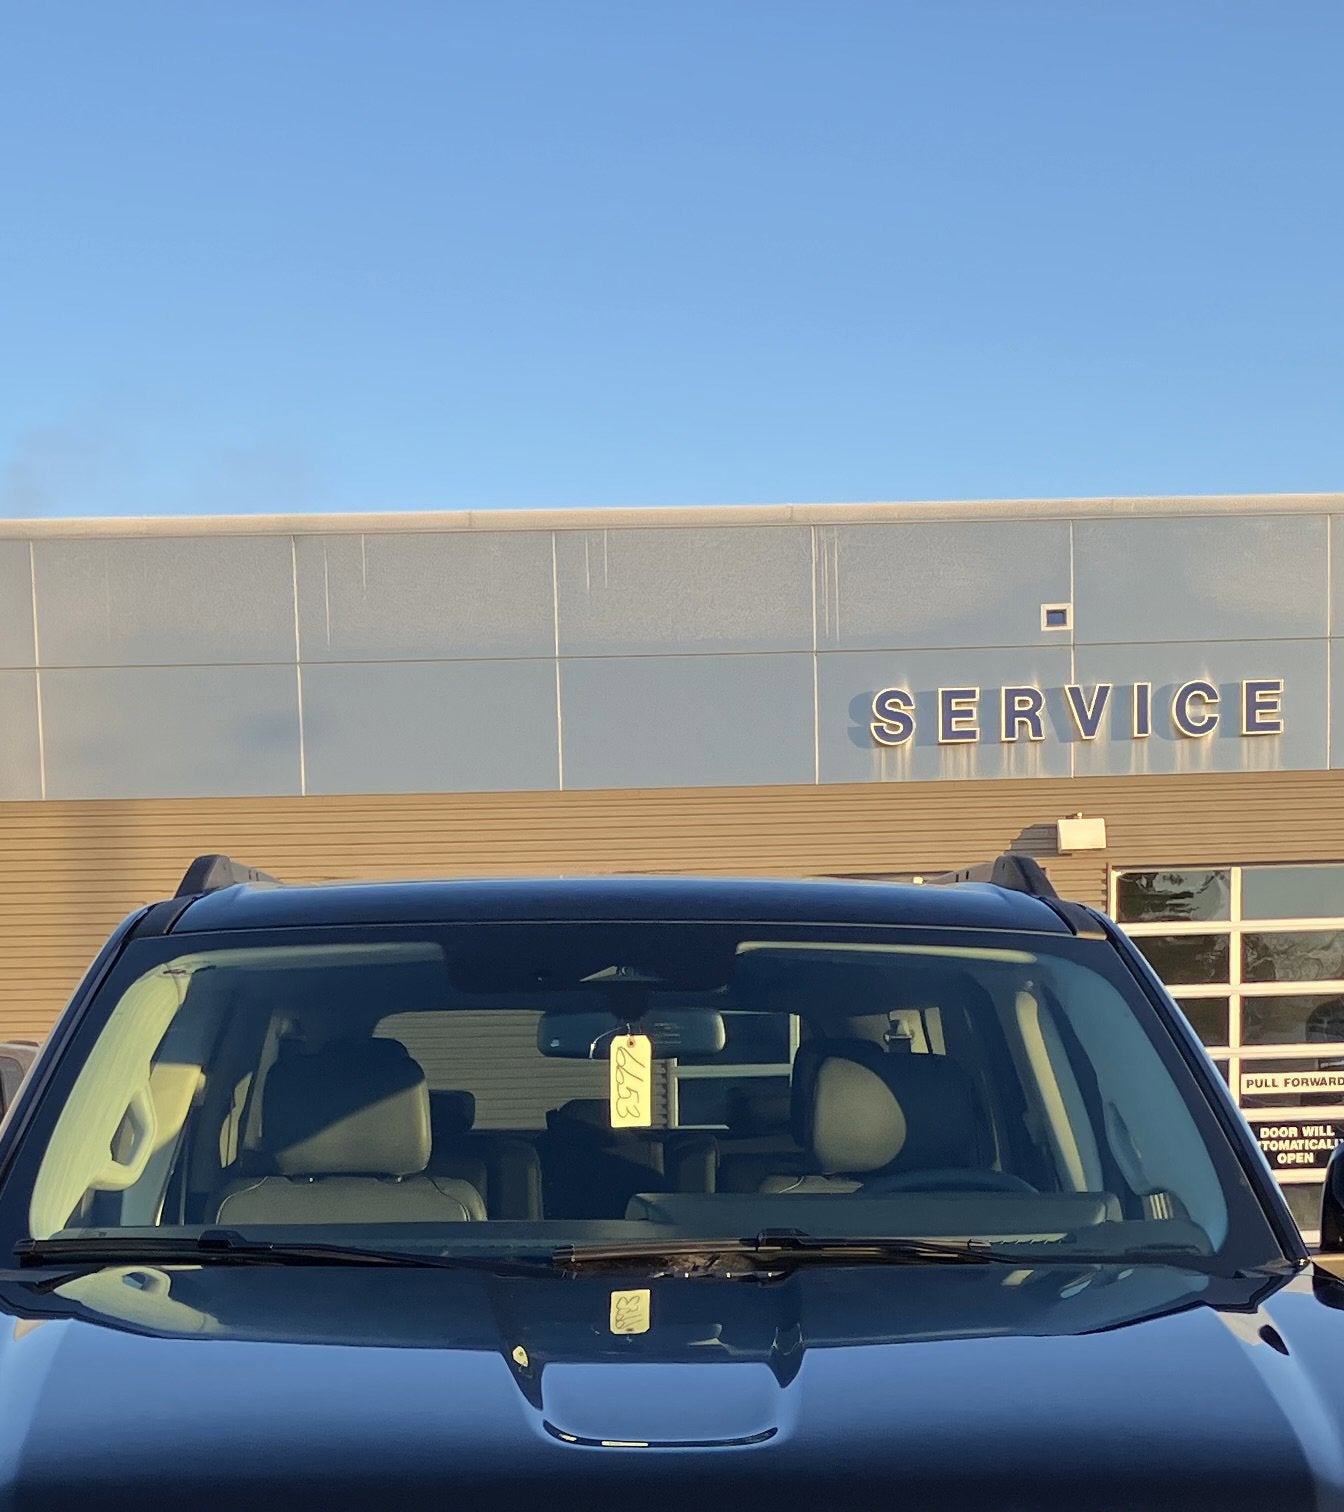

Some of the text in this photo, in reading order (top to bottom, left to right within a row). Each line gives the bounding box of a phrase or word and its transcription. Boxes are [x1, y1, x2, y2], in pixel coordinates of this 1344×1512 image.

[870, 678, 1284, 745] SERVICE
[616, 1046, 645, 1118] 6653
[1246, 1079, 1279, 1088] PULL
[1260, 1125, 1335, 1138] DOOR WILL
[1277, 1152, 1314, 1164] OPEN
